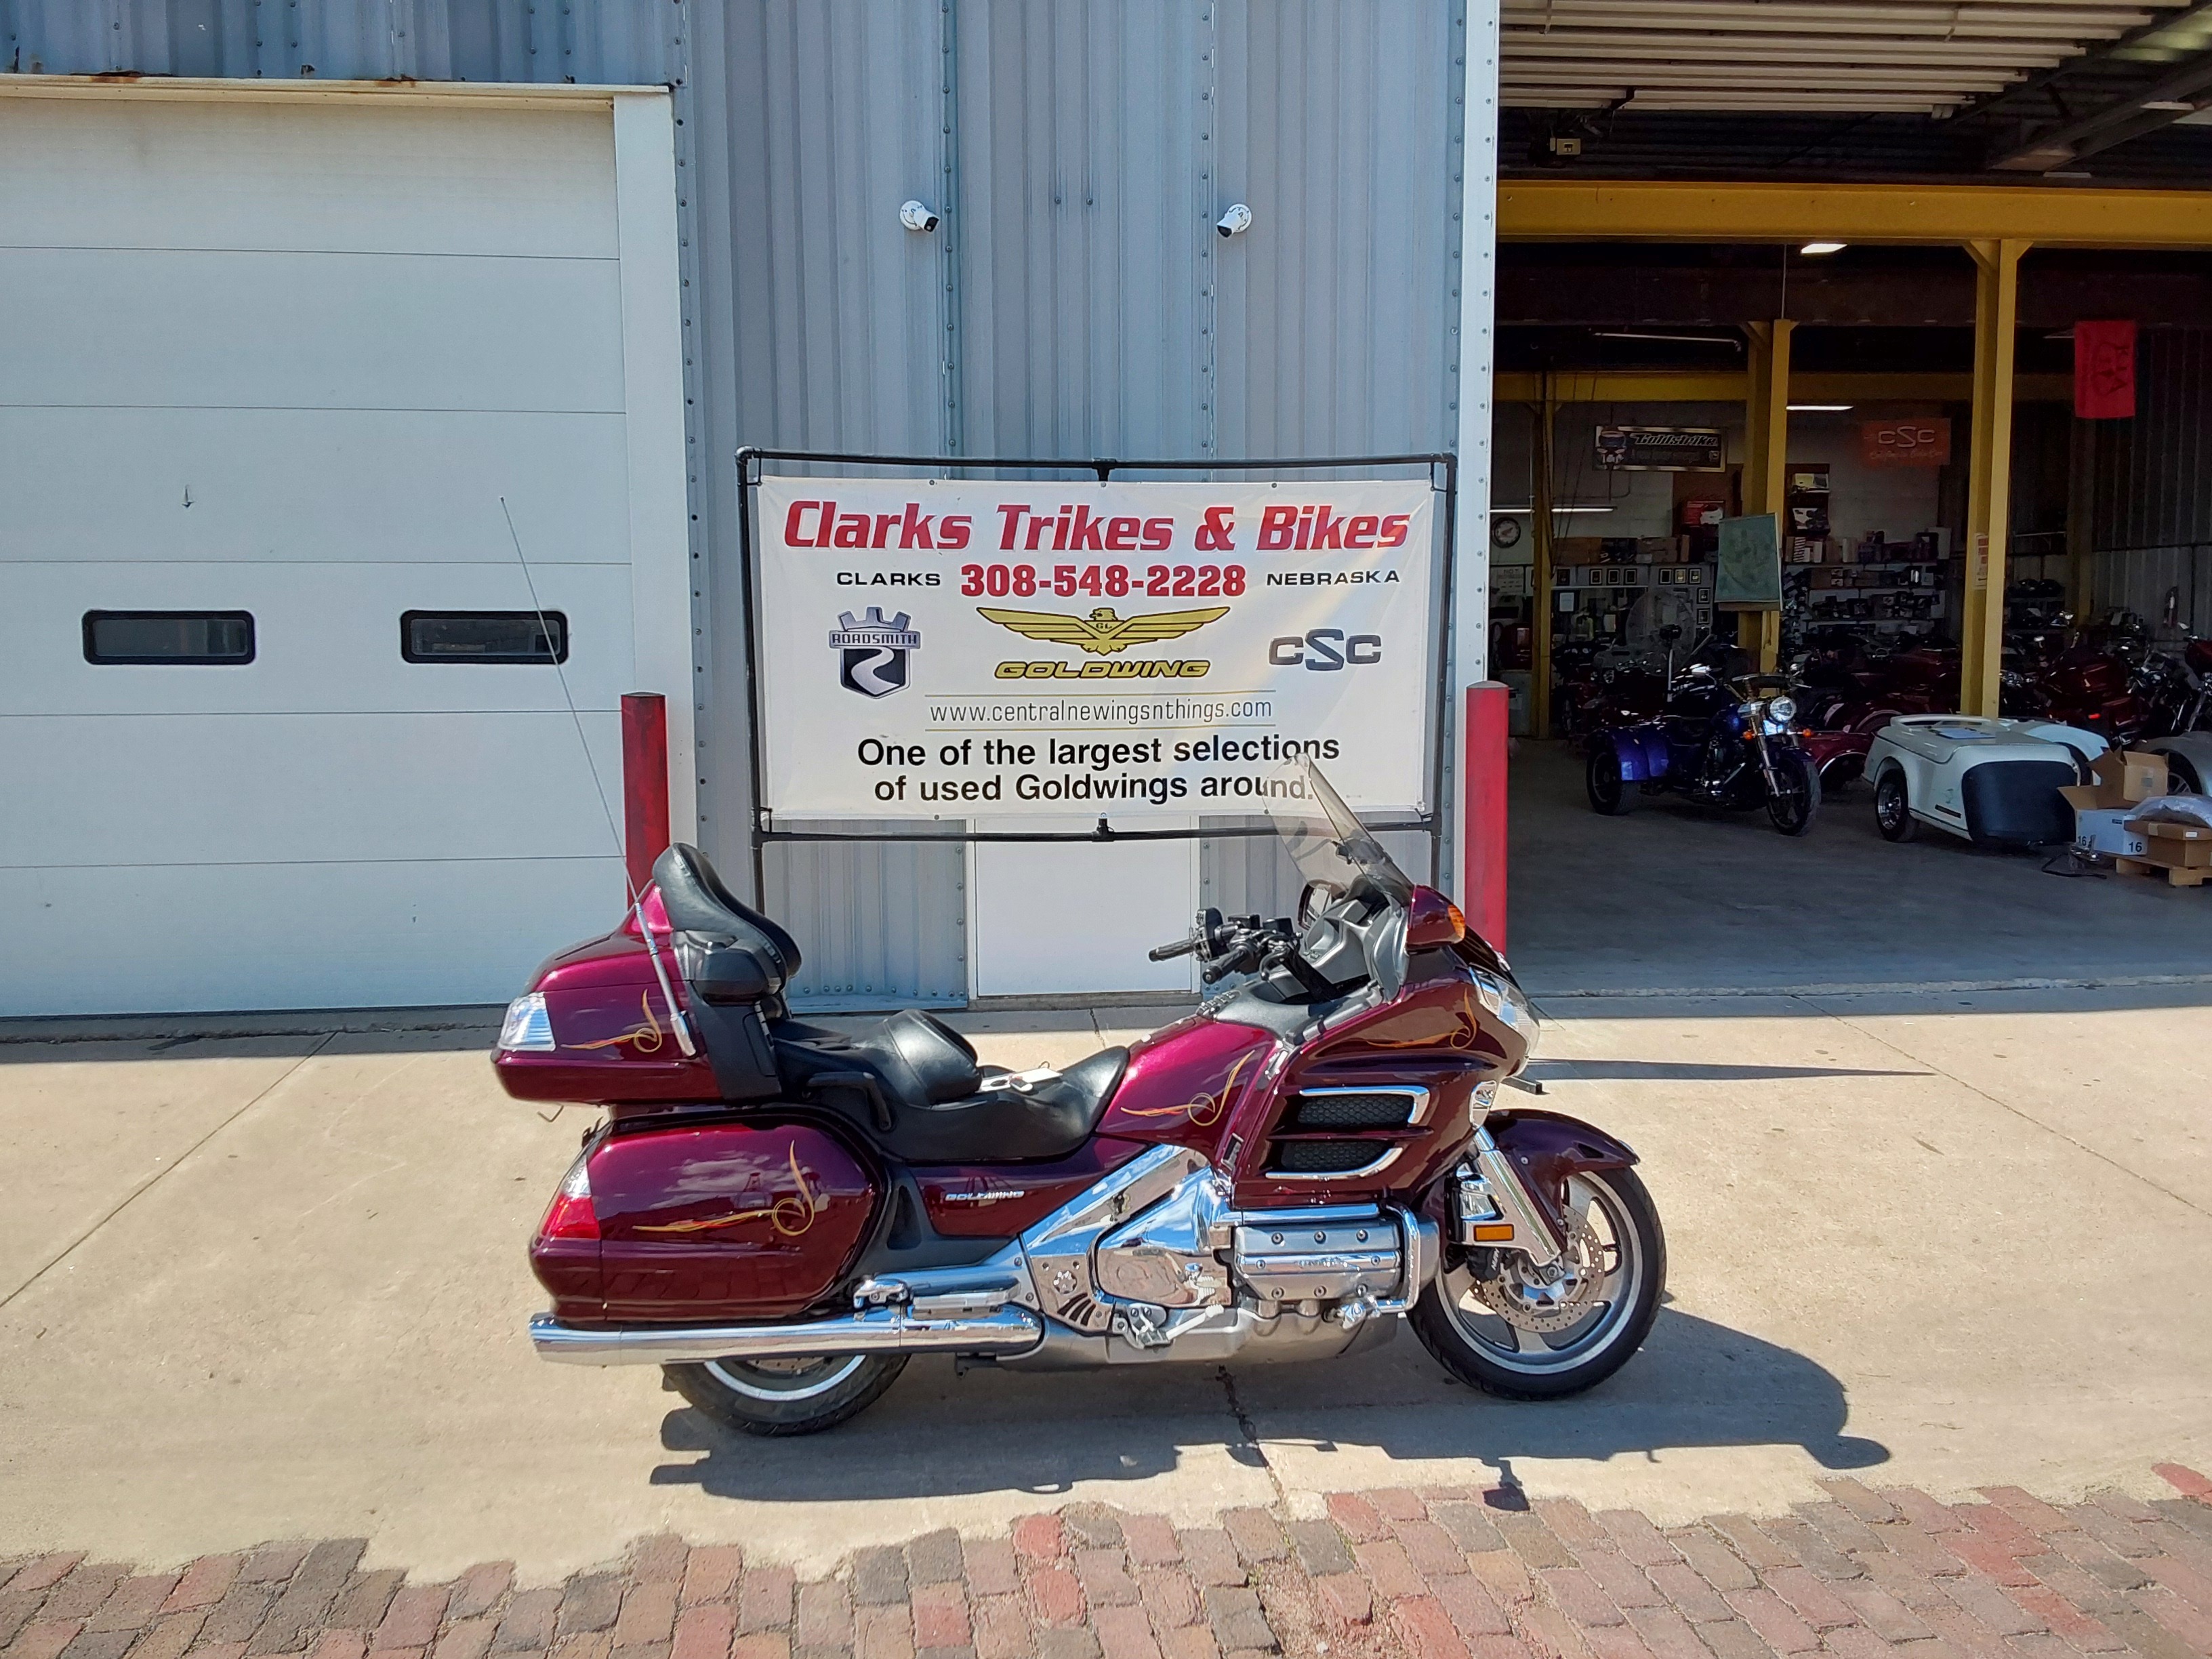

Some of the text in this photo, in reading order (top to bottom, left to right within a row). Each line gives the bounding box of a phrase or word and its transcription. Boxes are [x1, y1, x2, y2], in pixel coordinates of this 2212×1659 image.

[785, 501, 1410, 550] Clarks Trikes & Bikes
[837, 572, 941, 586] CLARKS
[961, 564, 1246, 597] 308-548-2228
[1267, 570, 1400, 586] NEBRASKA
[832, 633, 917, 644] ROADSMITH
[1269, 628, 1382, 671] CSC
[994, 660, 1210, 679] GOLDWING
[930, 699, 1272, 724] www.centralnewingsnthings.com
[858, 734, 1340, 771] One of the largest selections
[874, 773, 1313, 805] of used Goldwings around.
[2077, 836, 2087, 846] 16
[2128, 842, 2143, 852] 16
